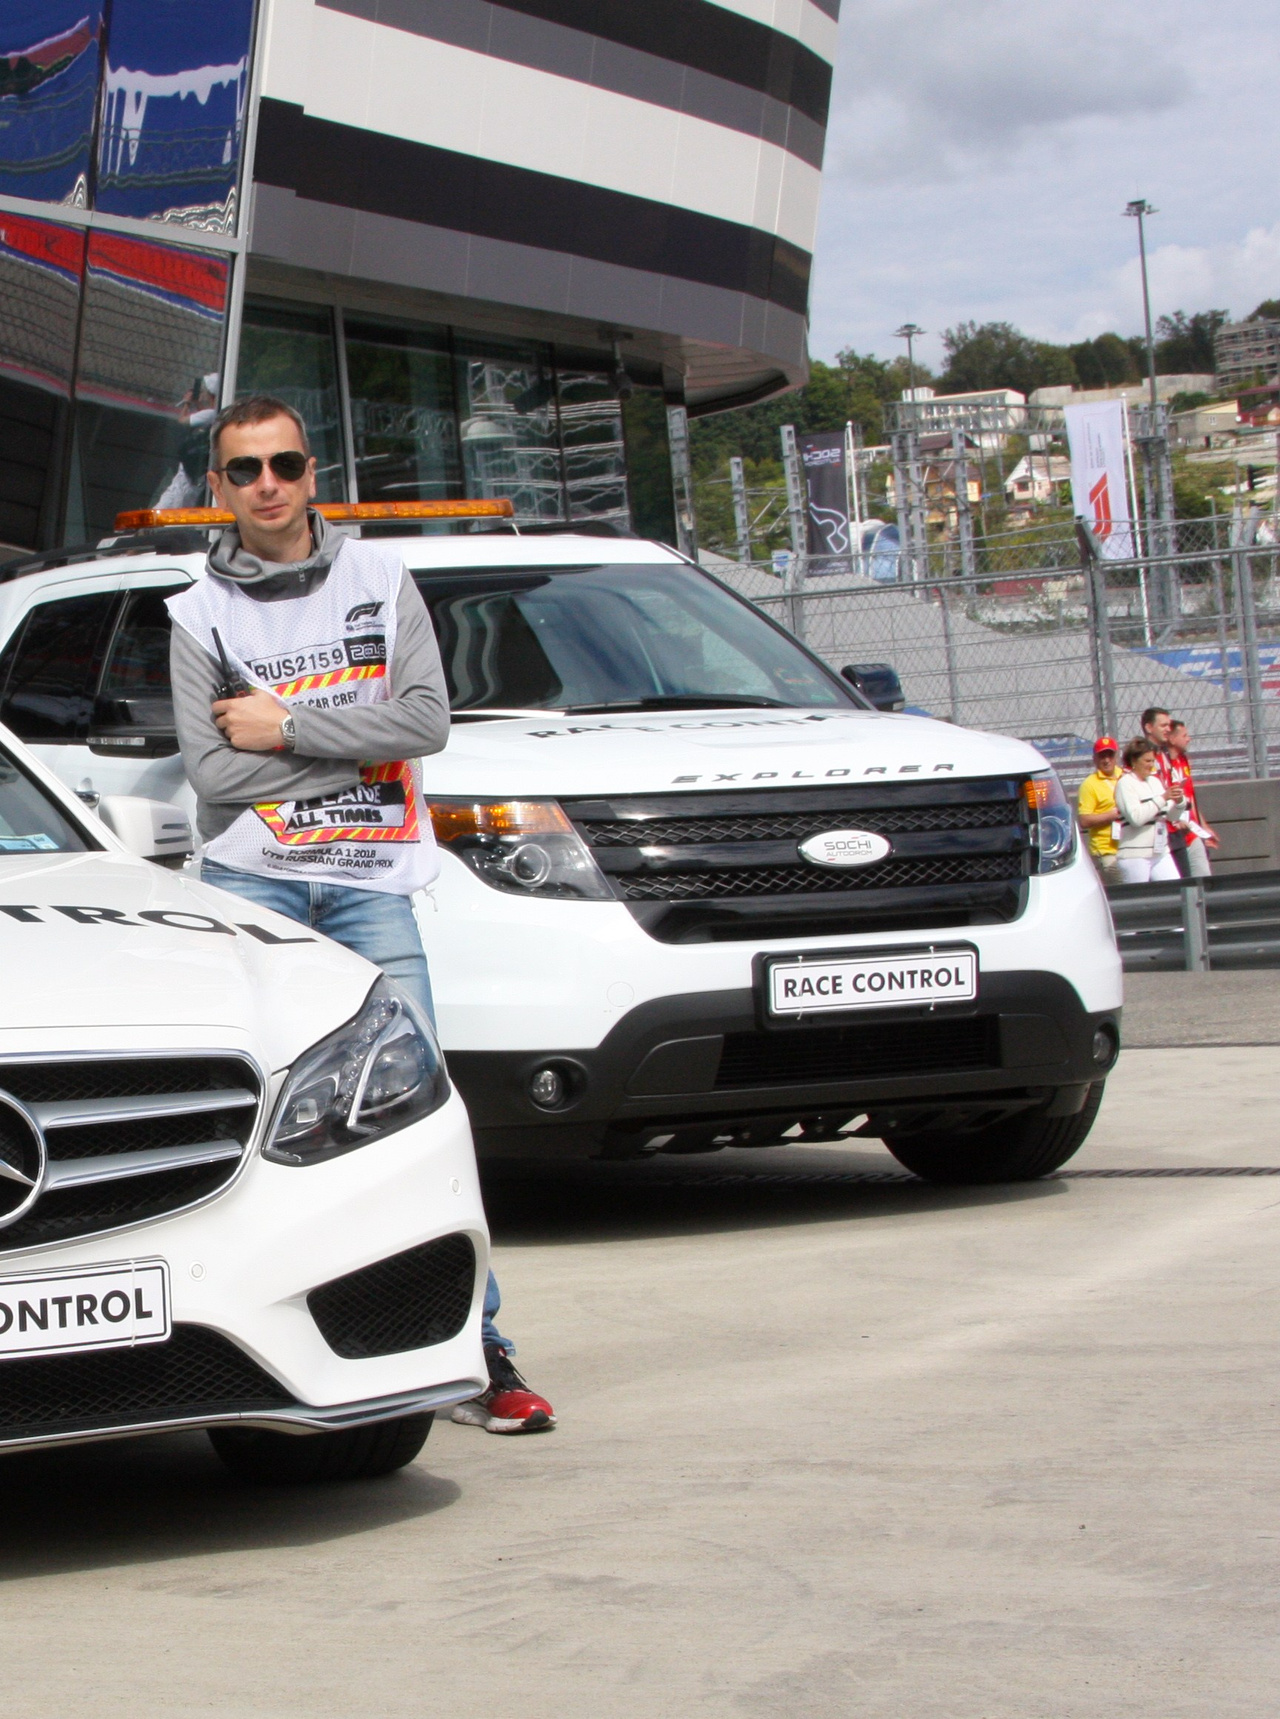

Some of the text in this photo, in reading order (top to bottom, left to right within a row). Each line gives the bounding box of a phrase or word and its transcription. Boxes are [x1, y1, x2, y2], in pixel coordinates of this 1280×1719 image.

[254, 643, 386, 682] RUS2159 2018
[671, 763, 955, 785] EXPLORER
[285, 810, 323, 830] ALL
[288, 847, 377, 858] FORMULA 1 2018
[824, 840, 872, 851] SOCHI
[262, 847, 395, 869] VTB RUSSIAN GRAND PRIX
[783, 966, 965, 998] RACE CONTROL
